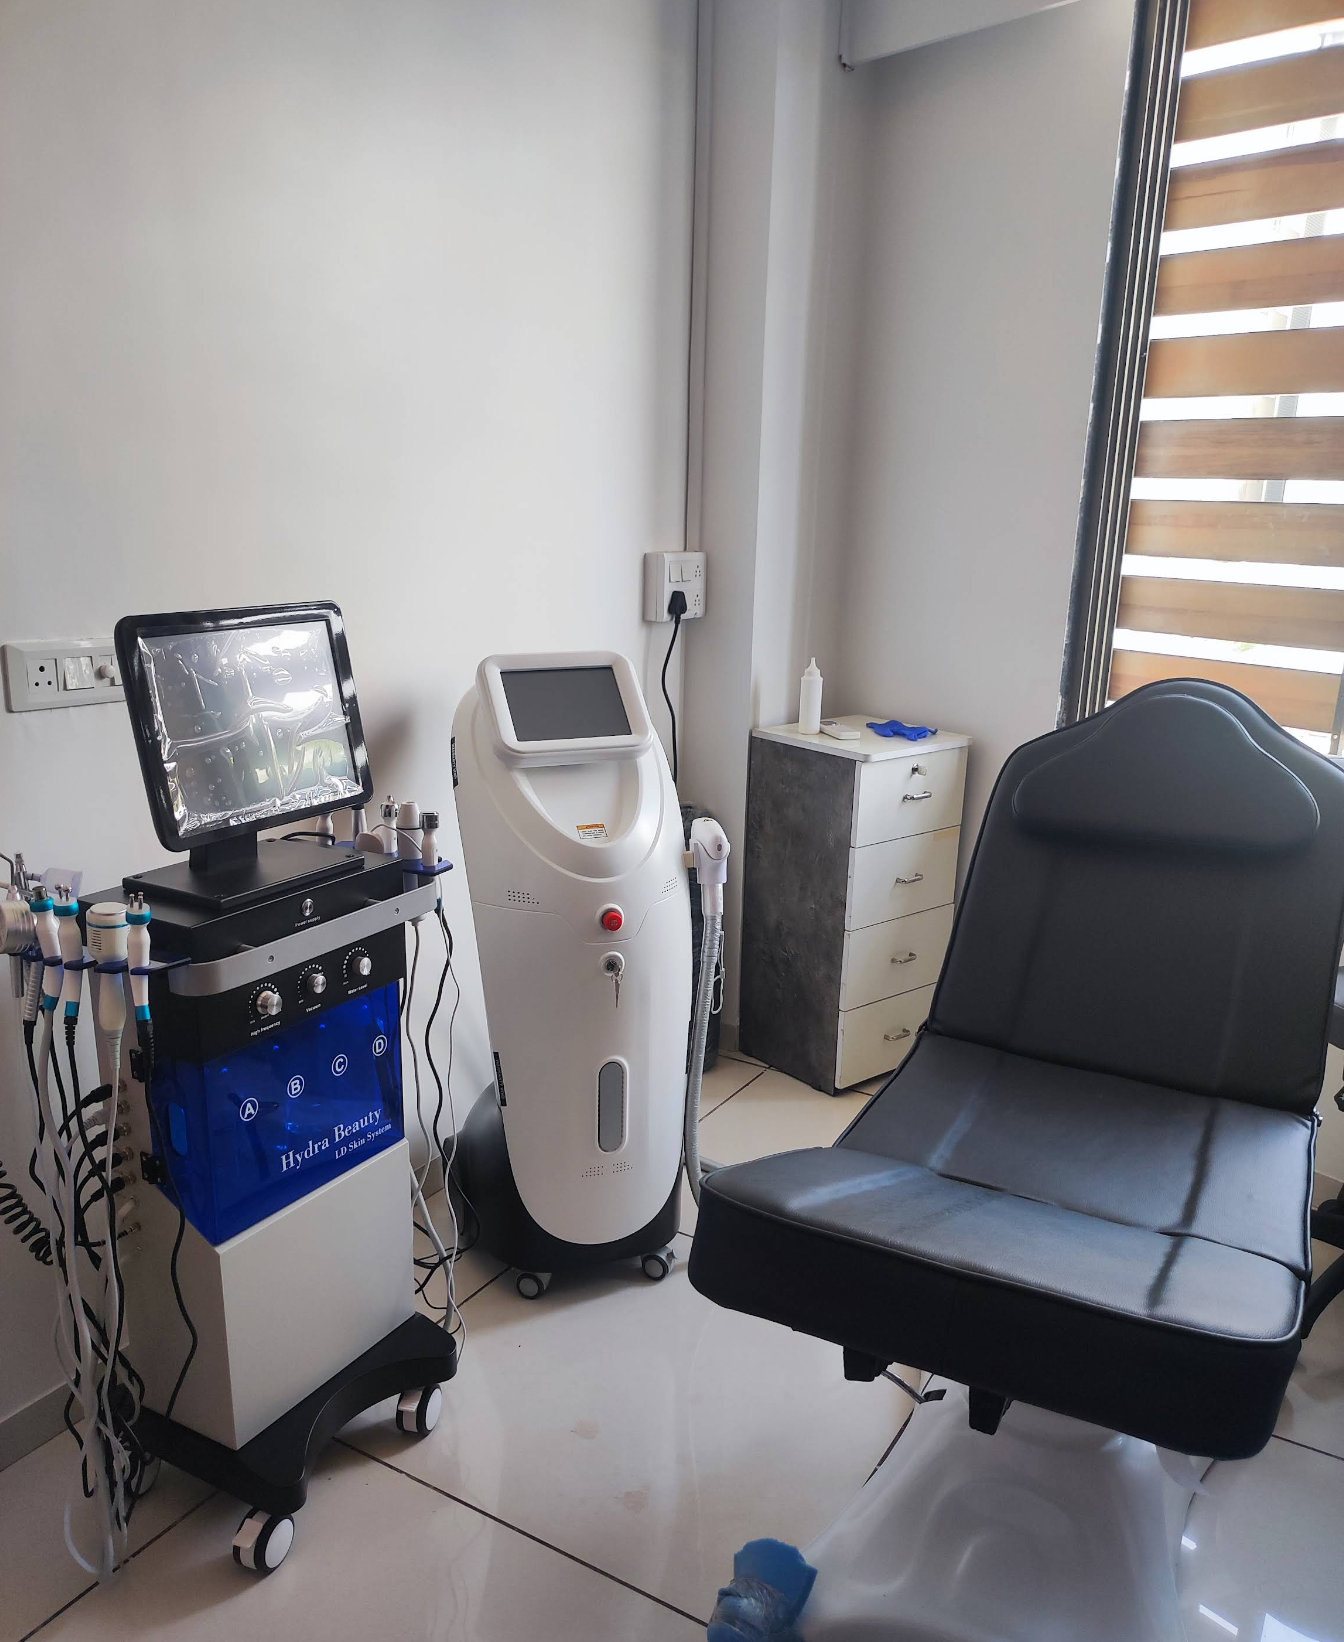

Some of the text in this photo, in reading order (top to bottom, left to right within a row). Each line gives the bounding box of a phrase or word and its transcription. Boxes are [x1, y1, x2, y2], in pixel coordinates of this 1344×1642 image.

[280, 1108, 381, 1173] Hydra Beauty
[348, 1137, 366, 1152] Skin
[366, 1123, 392, 1141] System
